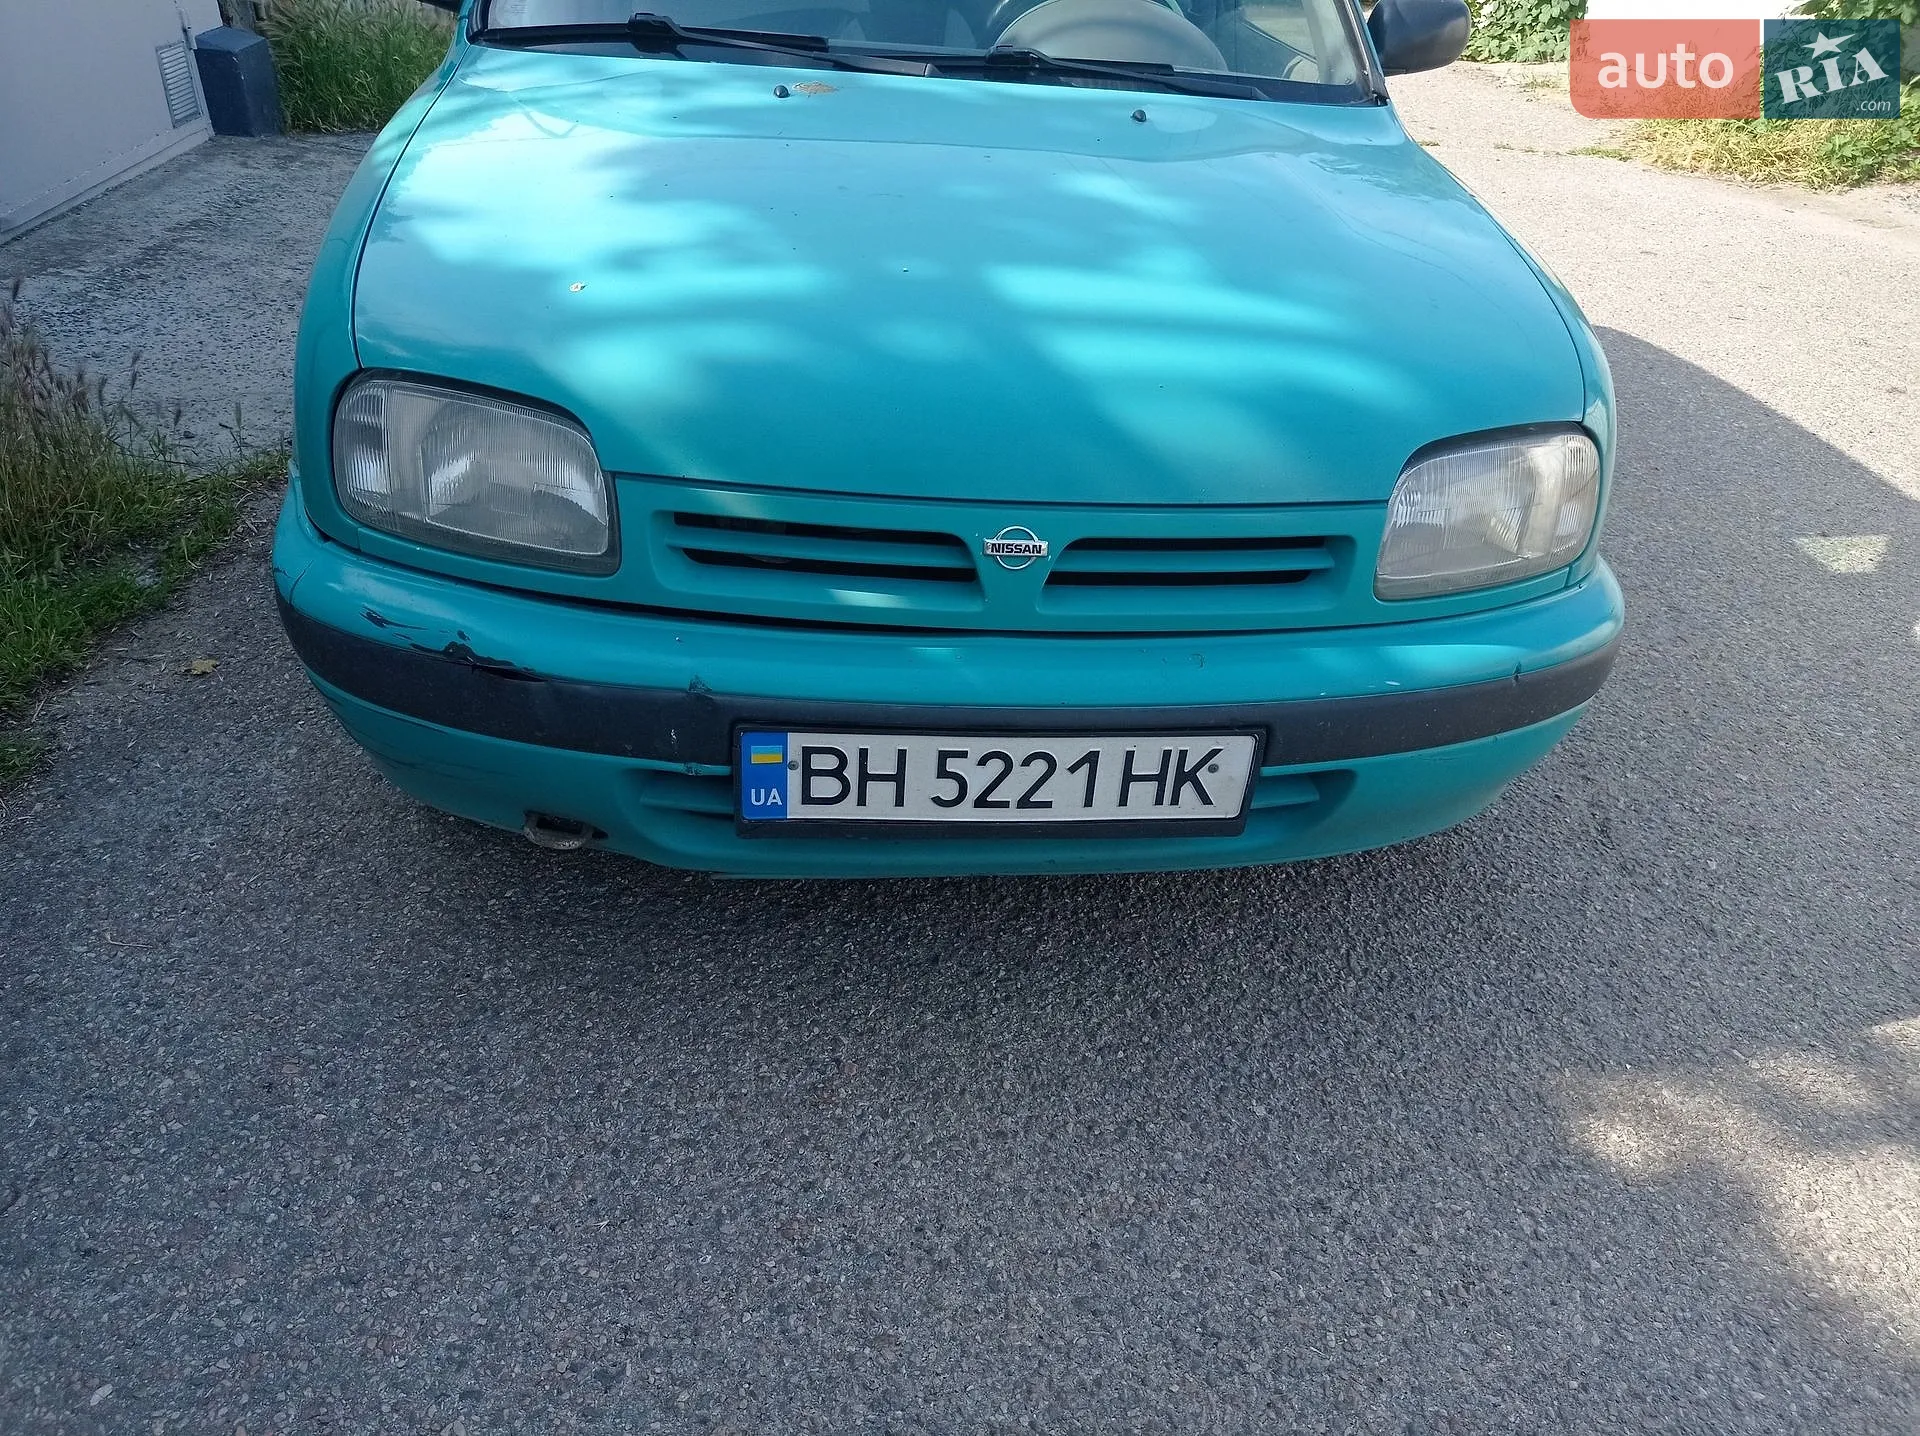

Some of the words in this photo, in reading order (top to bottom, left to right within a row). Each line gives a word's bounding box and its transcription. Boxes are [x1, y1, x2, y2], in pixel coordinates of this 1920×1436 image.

[991, 542, 1042, 555] NISSAN
[801, 745, 907, 807] BH
[930, 749, 1102, 809] 5221
[1117, 748, 1224, 807] HK
[751, 788, 783, 806] UA
